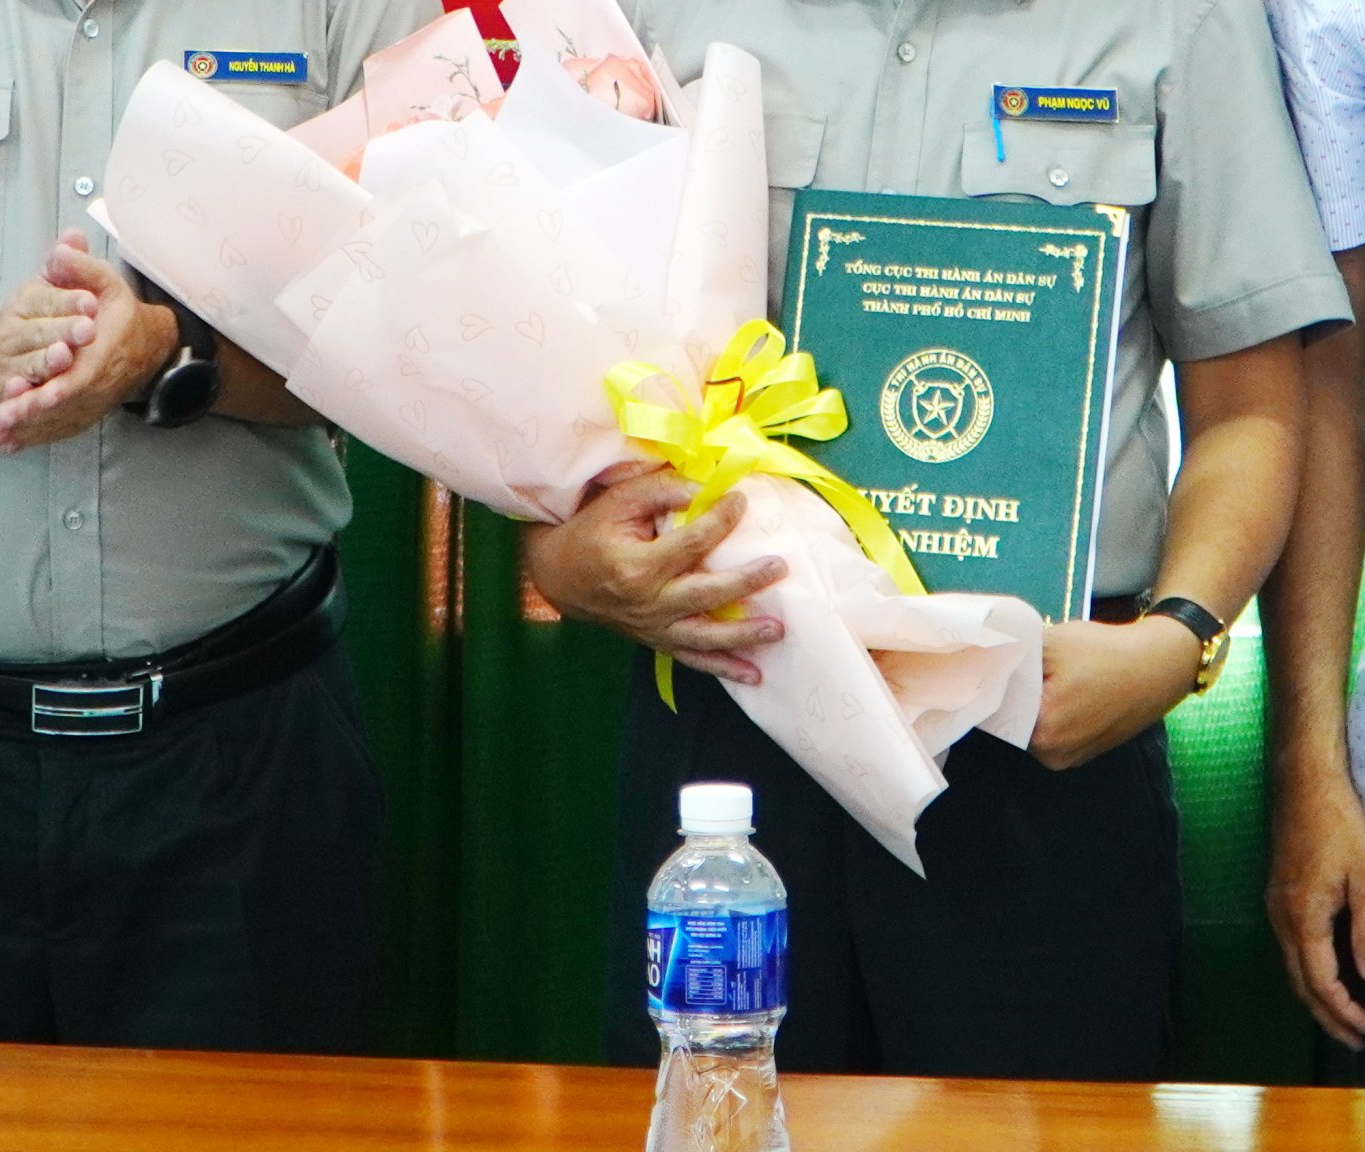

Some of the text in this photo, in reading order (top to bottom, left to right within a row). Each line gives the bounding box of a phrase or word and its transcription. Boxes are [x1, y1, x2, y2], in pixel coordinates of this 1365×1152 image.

[259, 61, 283, 73] THANH
[1037, 96, 1065, 110] PHẠM
[1067, 98, 1094, 111] NGỌC
[884, 265, 913, 279] CỤC
[915, 266, 939, 280] THI
[941, 267, 980, 283] HÀNH
[982, 269, 1003, 284] ÁN
[1005, 271, 1035, 286] DÂN
[1037, 274, 1057, 289] SỰ
[862, 282, 1035, 306] CỤC THI HÀNH ÁN DÂN SỰ
[862, 298, 910, 315] THÀNH
[912, 301, 942, 317] PHỐ
[966, 306, 992, 321] CHÍ
[994, 309, 1031, 323] MINH
[941, 495, 1021, 524] ĐỊNH
[898, 527, 1001, 561] NHIỆM
